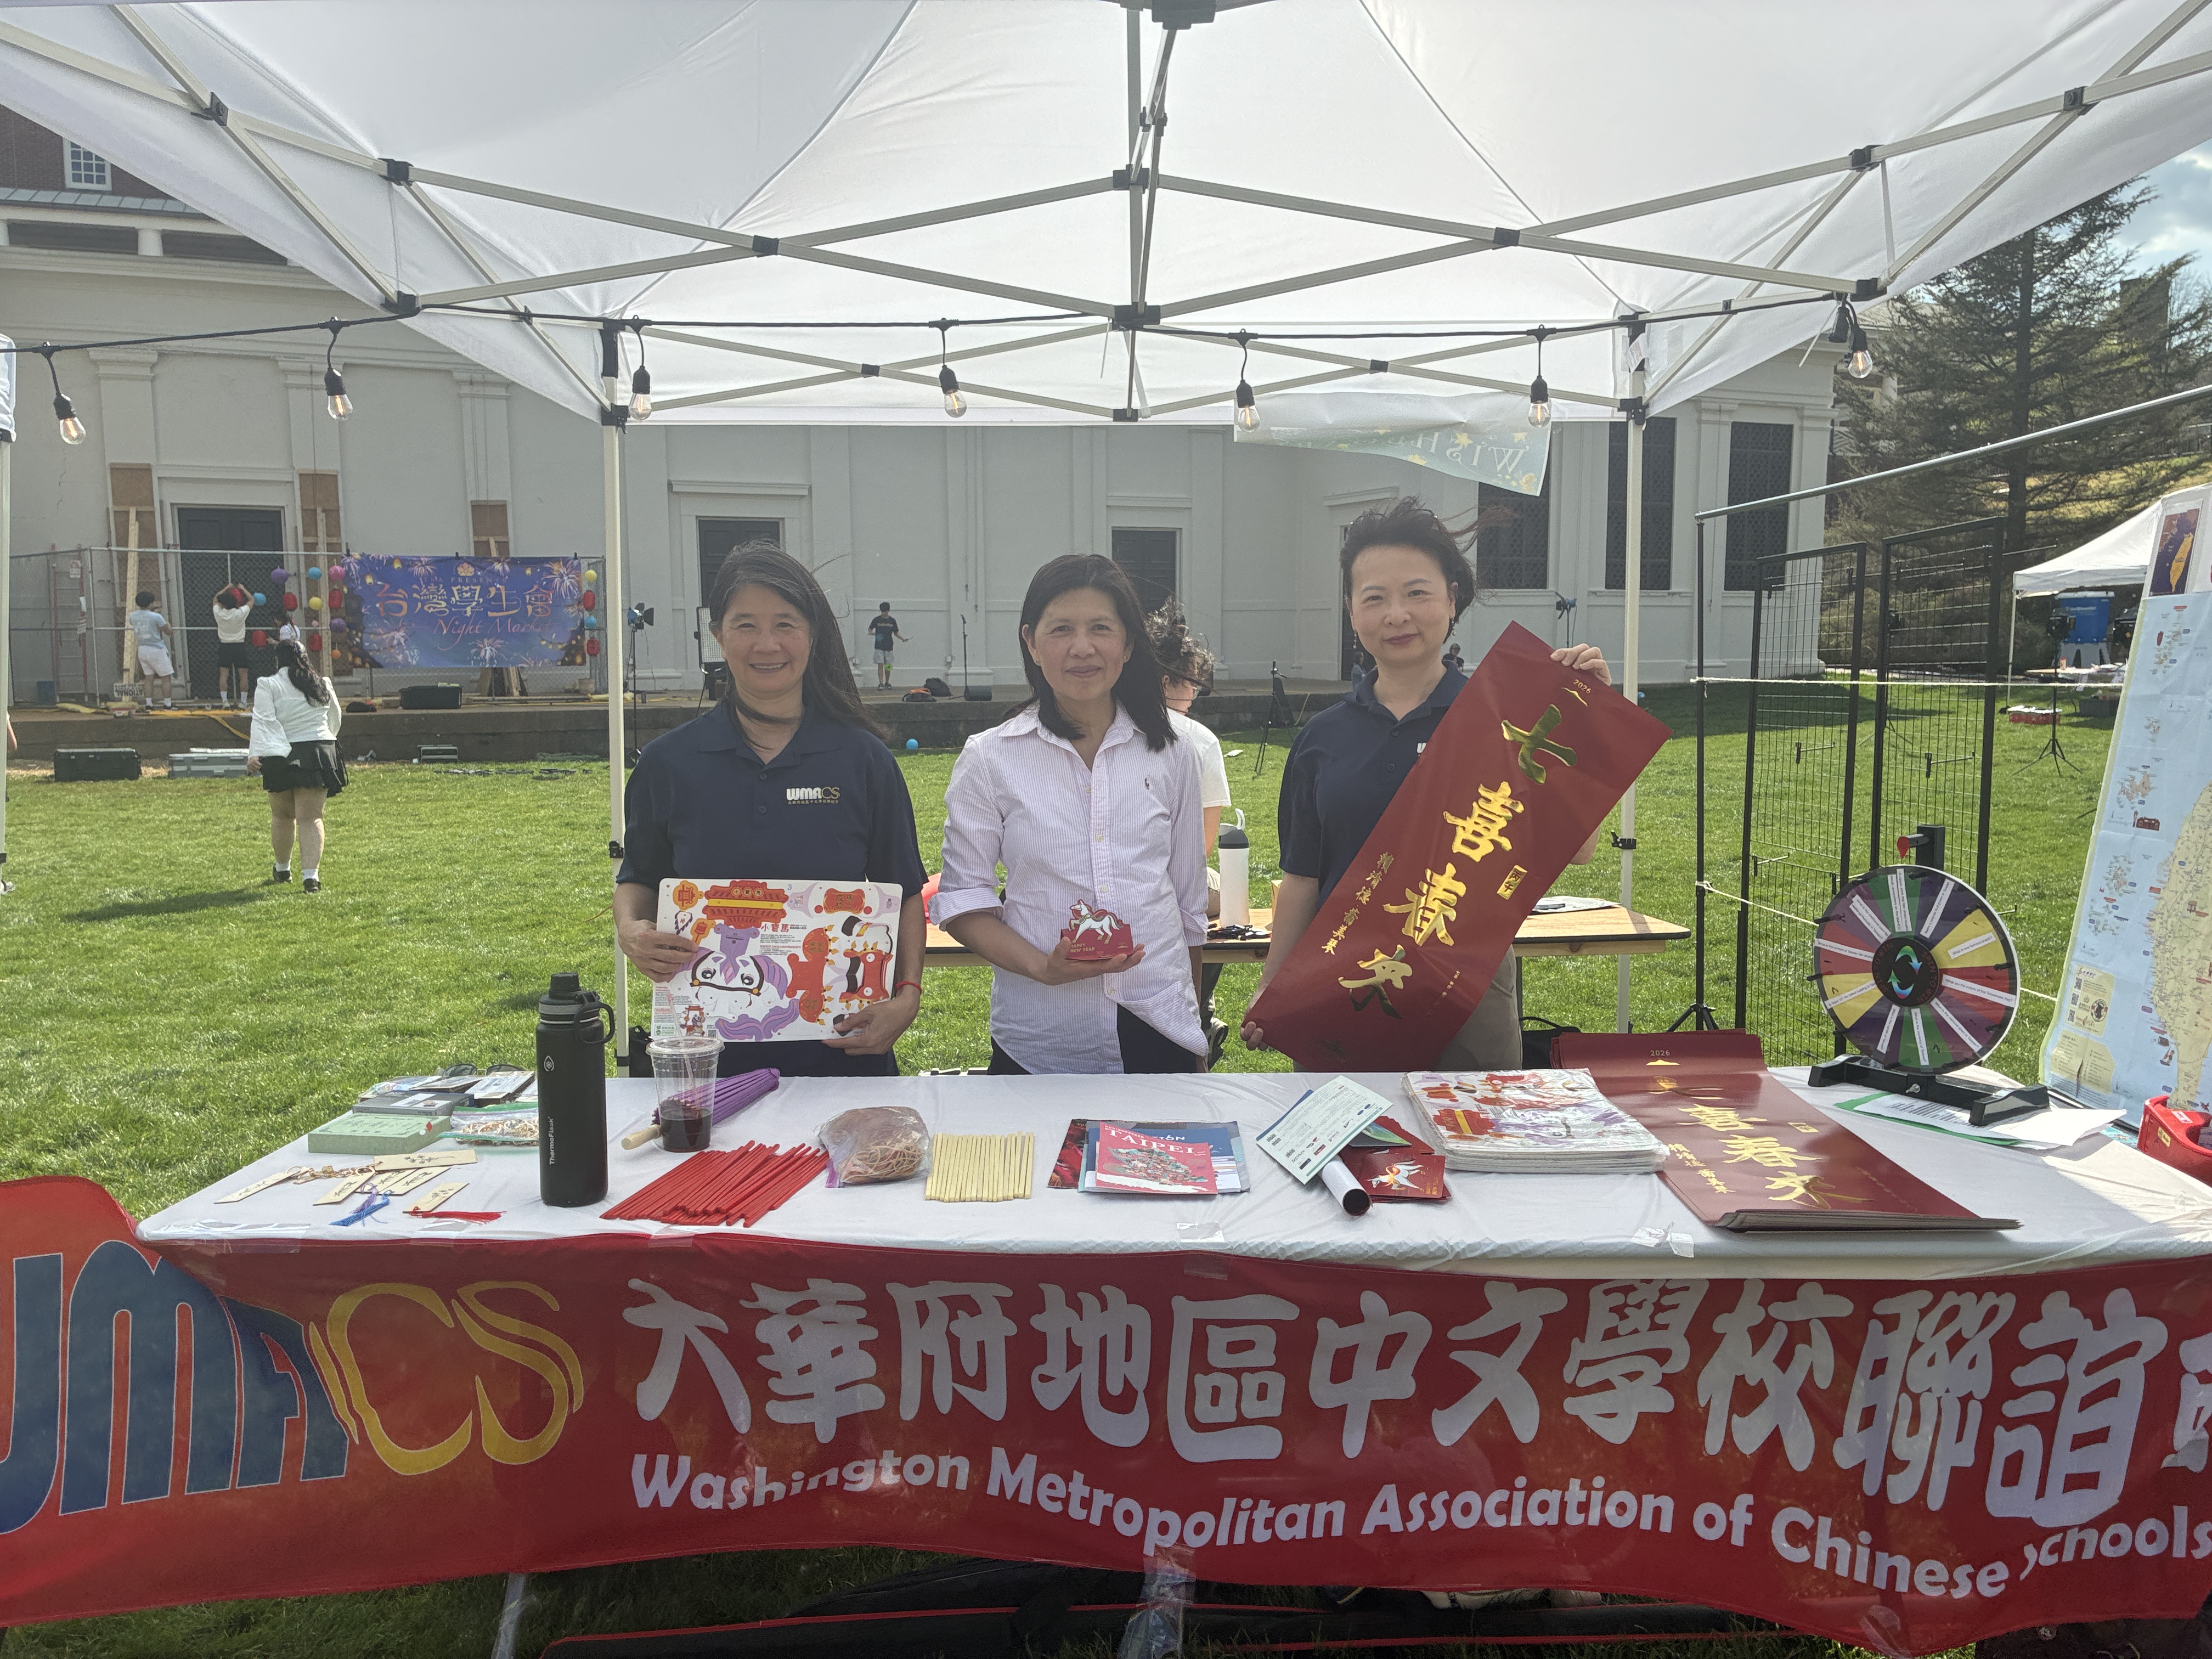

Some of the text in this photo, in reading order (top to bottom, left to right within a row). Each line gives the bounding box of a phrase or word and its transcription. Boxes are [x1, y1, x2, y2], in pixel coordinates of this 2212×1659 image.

[376, 584, 553, 617] 台灣學生會
[434, 610, 552, 651] Night Market
[1572, 679, 1592, 695] 2026
[786, 787, 840, 800] WMACS
[1104, 1127, 1195, 1154] TAIPEI
[622, 1277, 2212, 1528] 大華府地區中文學校聯誼
[630, 1448, 970, 1510] Washington
[987, 1447, 1347, 1557] Metropolitan
[1361, 1476, 1674, 1534] Association
[1693, 1493, 1754, 1548] of
[1771, 1506, 2006, 1600] Chinese
